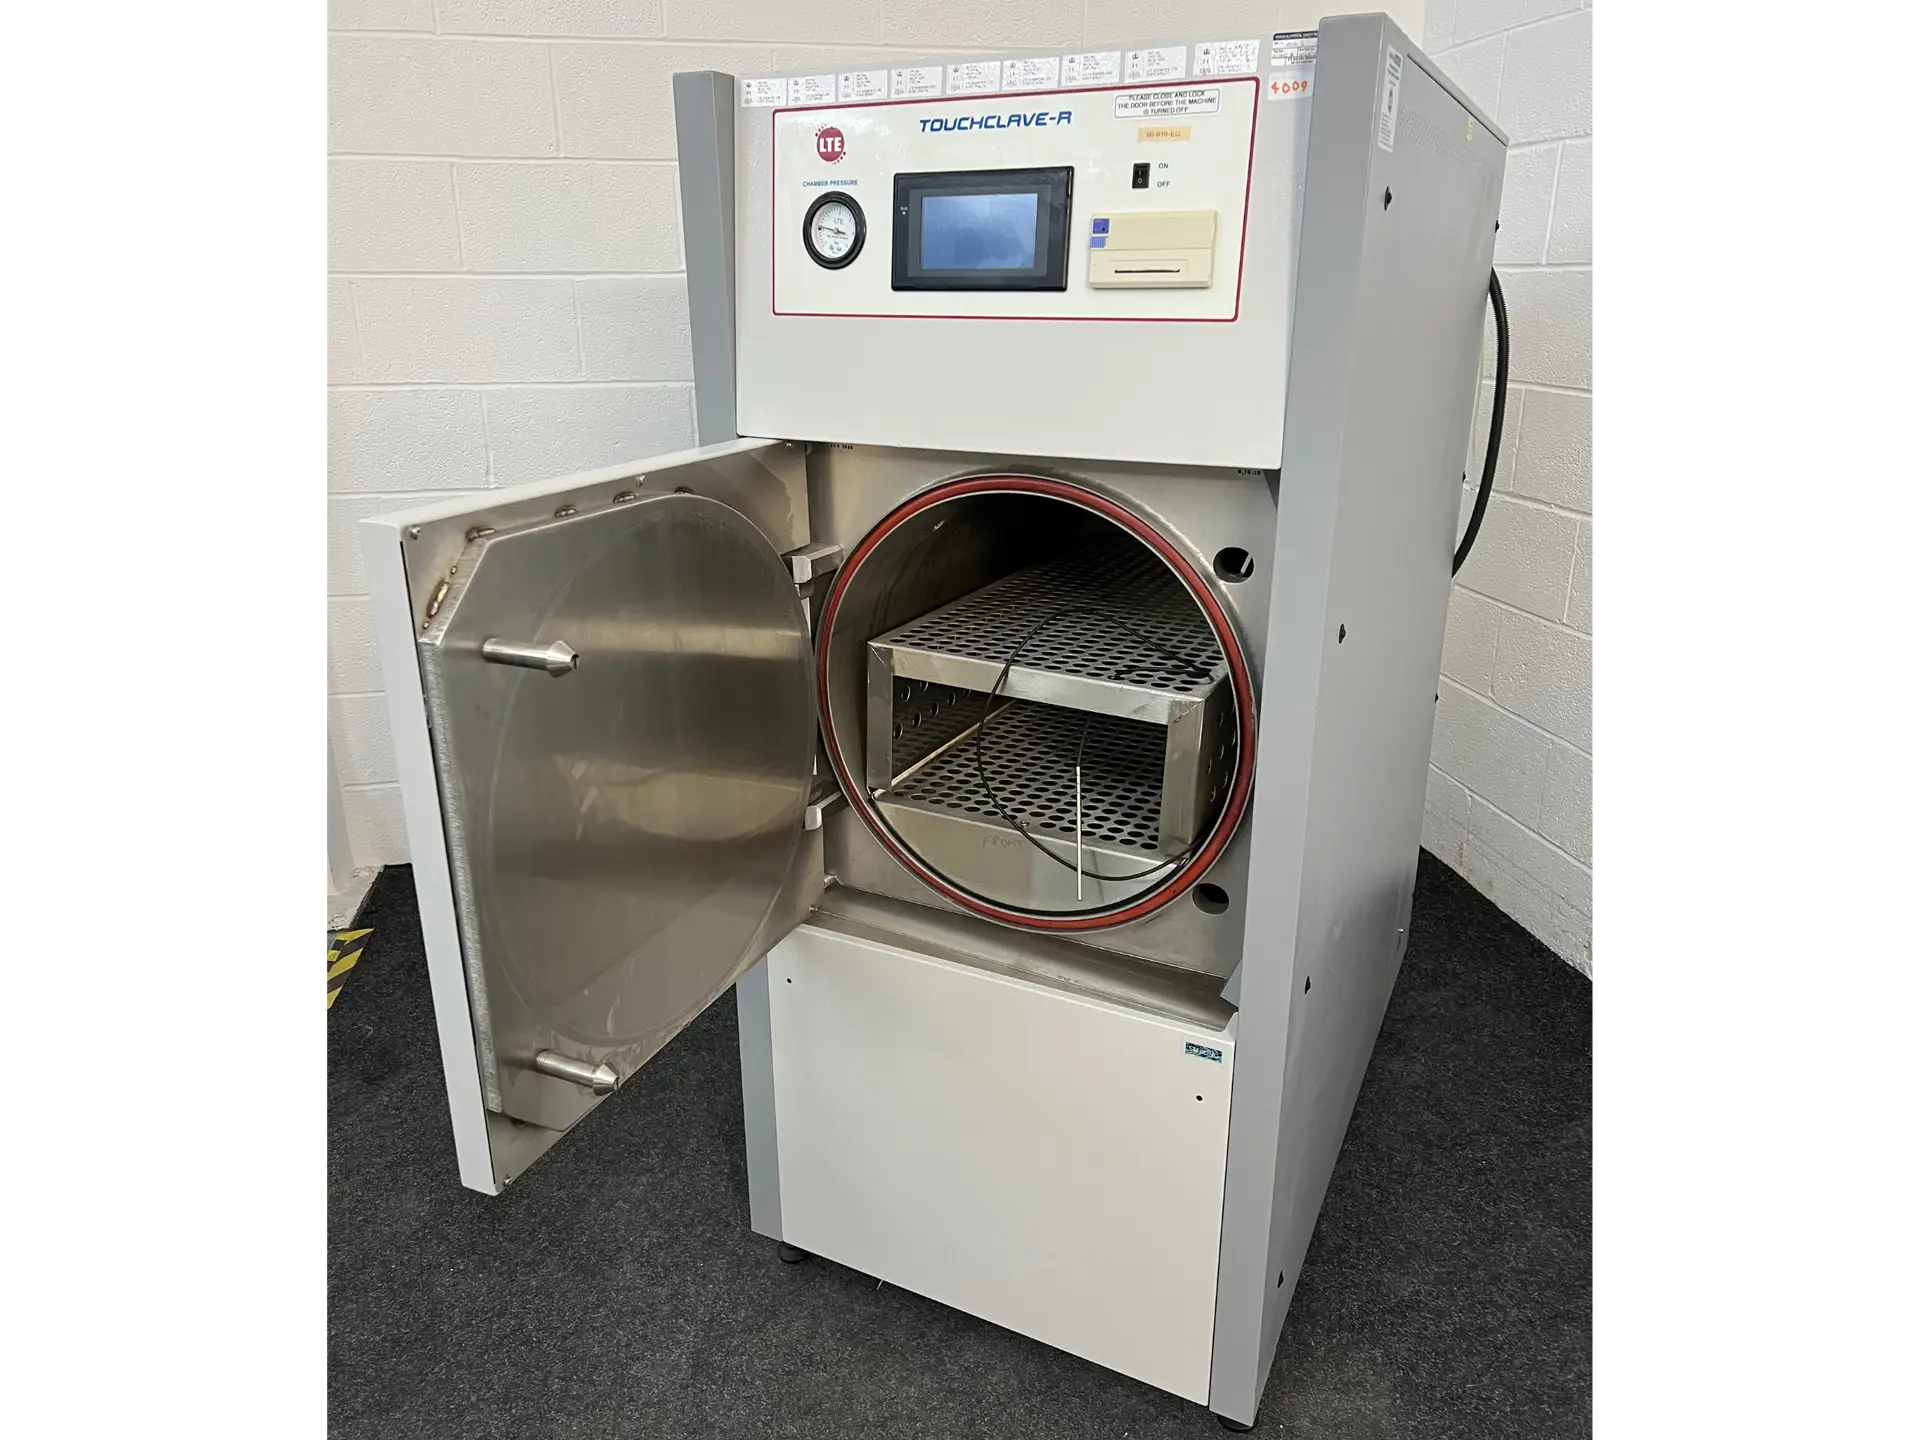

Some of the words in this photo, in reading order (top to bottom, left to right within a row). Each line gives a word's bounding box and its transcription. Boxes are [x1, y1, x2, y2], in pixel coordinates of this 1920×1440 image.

[1271, 80, 1308, 94] 4009
[1129, 93, 1151, 101] PLEASE
[1153, 92, 1173, 100] CLOSE
[1174, 91, 1187, 99] AND
[1188, 90, 1206, 98] LOCK
[1149, 100, 1173, 108] BEFORE
[1188, 97, 1217, 105] MACHINE
[1150, 107, 1175, 115] TURNED
[919, 110, 1073, 133] TOUCHCLAVE-R
[819, 137, 842, 153] LTE
[803, 180, 828, 188] CHAMBER
[829, 179, 858, 187] PRESSURE
[1157, 180, 1171, 188] OFF
